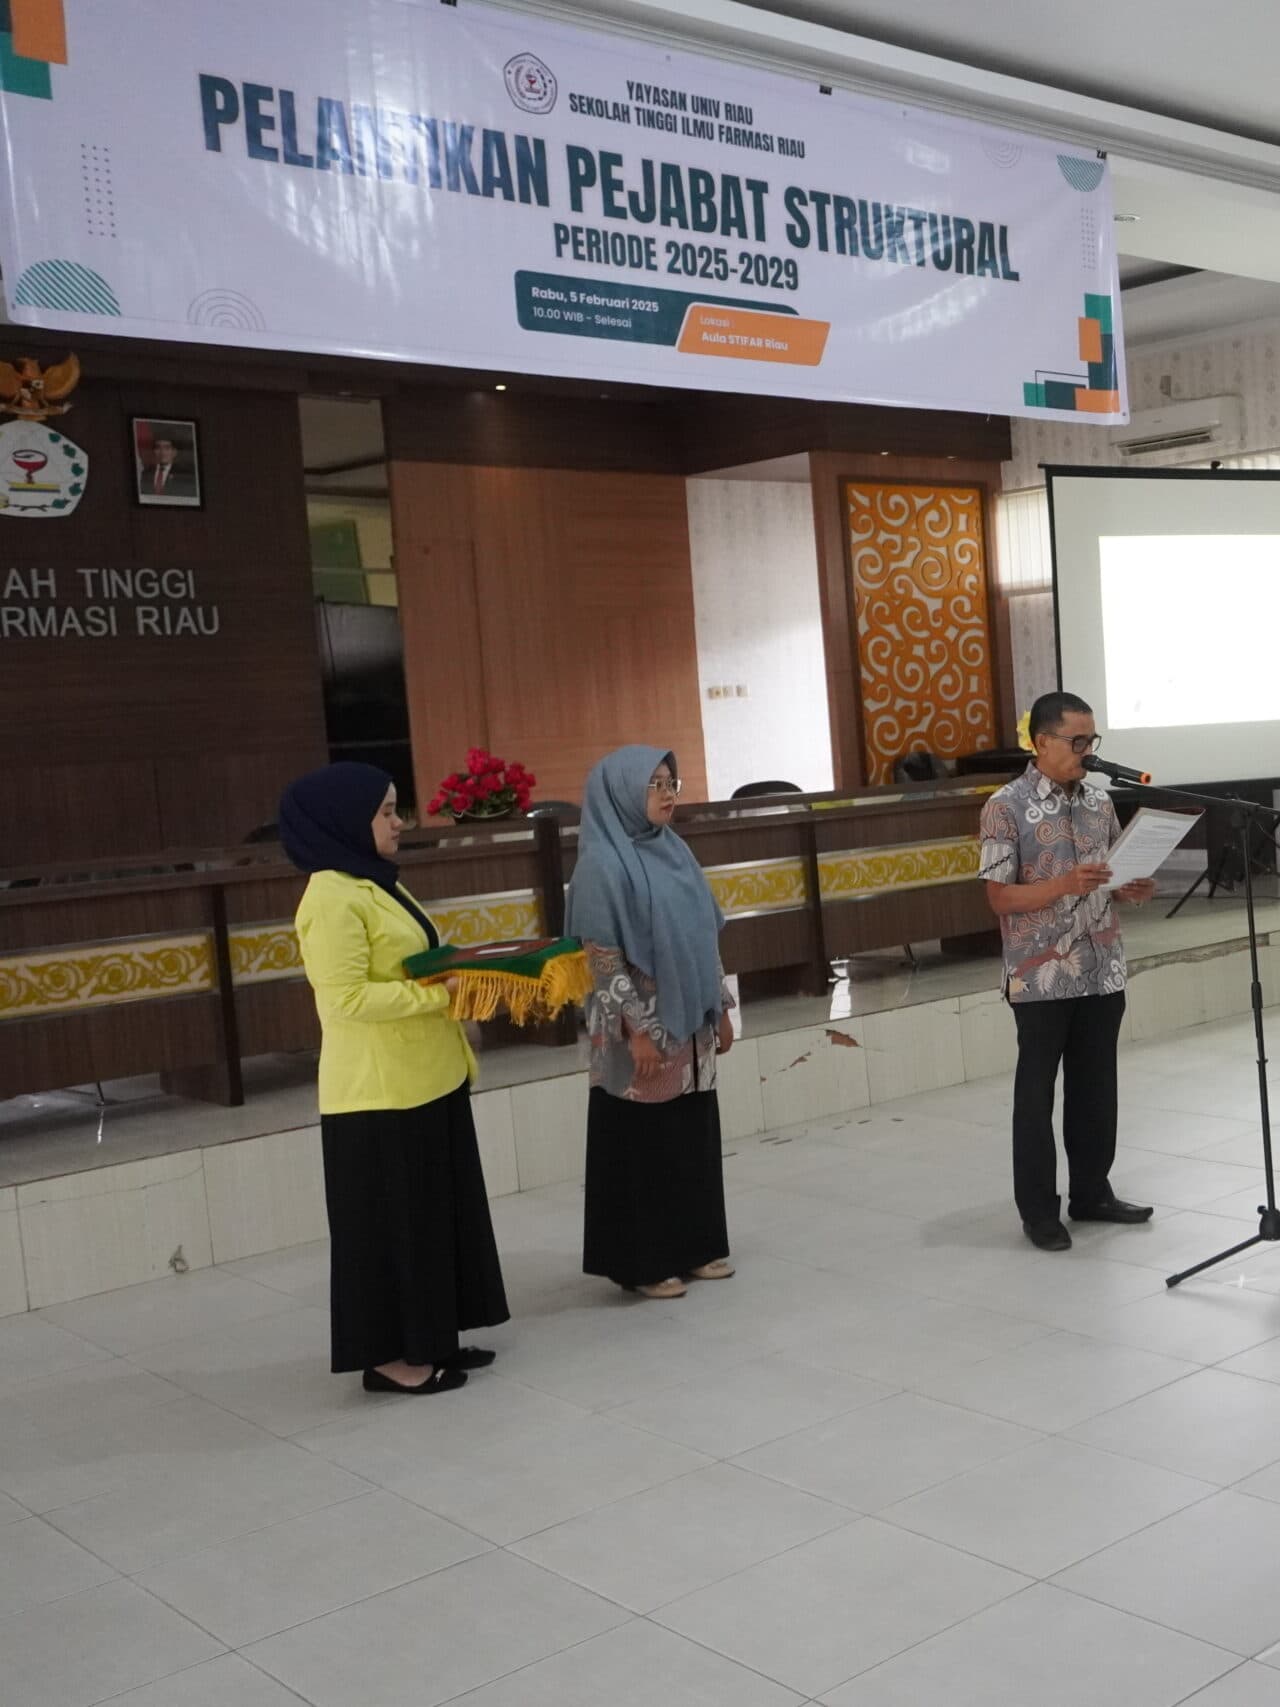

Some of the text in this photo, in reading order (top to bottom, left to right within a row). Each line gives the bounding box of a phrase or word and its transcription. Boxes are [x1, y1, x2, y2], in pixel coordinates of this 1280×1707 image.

[626, 80, 753, 126] YAYASAN UNIV RIAU
[568, 93, 805, 159] SEKOLAH TINGGI ILMU FARMASI RIAU
[566, 144, 769, 242] PEJABAT
[785, 186, 1020, 281] STRUKTURAL
[553, 222, 799, 291] PERIODE 2025-2029
[531, 286, 660, 313] Rabu, 5 Februari 2025
[533, 306, 561, 319] 10.00
[563, 311, 584, 322] WIB
[594, 314, 632, 328] Selesai
[702, 331, 789, 352] Aula STIFAR Riau
[3, 568, 195, 599] AH TINGGI
[0, 606, 220, 638] RMASI RIAU
